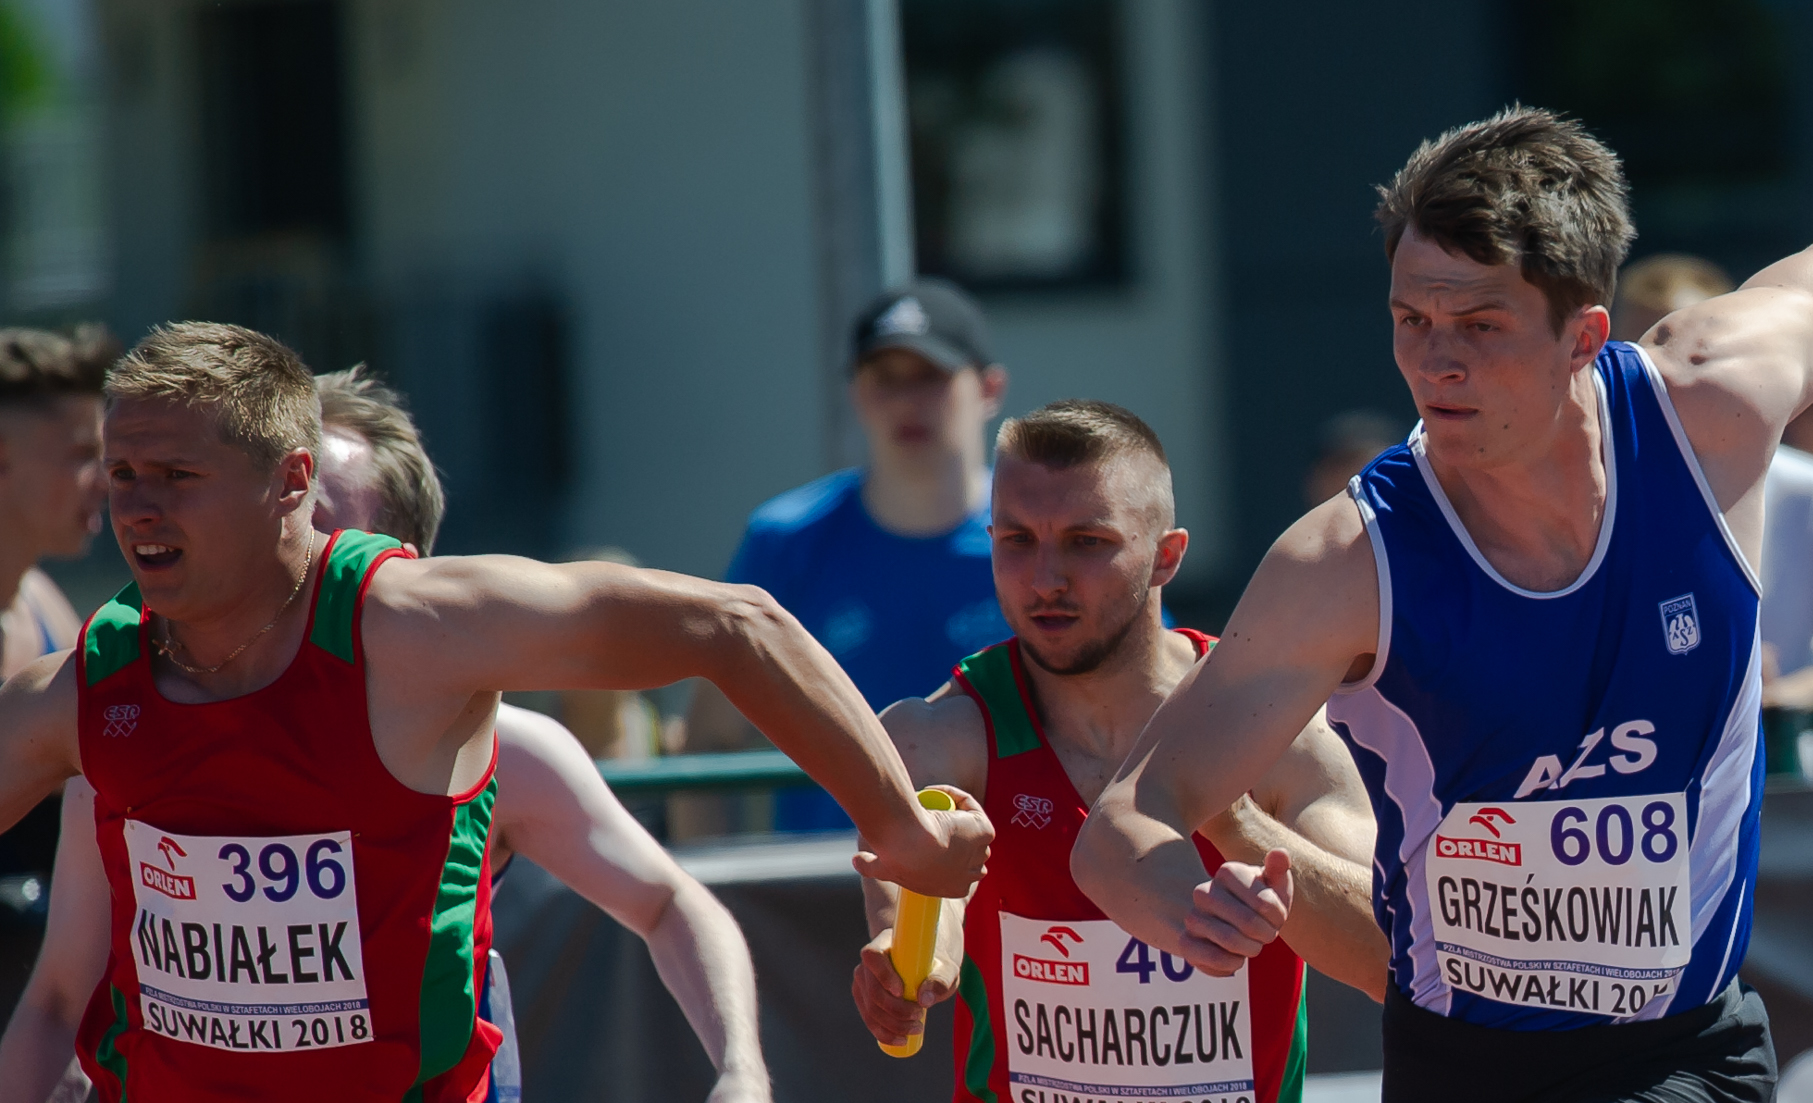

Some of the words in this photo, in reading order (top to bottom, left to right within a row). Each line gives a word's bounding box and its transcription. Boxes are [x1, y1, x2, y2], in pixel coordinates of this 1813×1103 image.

[1513, 719, 1657, 799] AZS
[1439, 840, 1516, 863] ORLEN
[1550, 801, 1678, 866] 608
[143, 866, 190, 897] ORLEN
[217, 838, 346, 903] 396
[1437, 873, 1680, 948] GRZEŚKOWIAK
[137, 908, 355, 984] NABIAŁEK
[1016, 959, 1084, 983] ORLEN
[1443, 944, 1462, 955] PZLA
[1462, 949, 1512, 968] MISTRZOSTWA
[1513, 961, 1542, 970] POLSKI
[1553, 962, 1600, 975] SZTAFETACH
[1605, 967, 1663, 978] WIELOBOJACH
[223, 1005, 230, 1013] W
[231, 1005, 278, 1014] SZTAFETACH
[283, 1002, 342, 1014] WIELOBOJACH
[343, 1001, 361, 1010] 2018
[1446, 957, 1600, 1011] SUWAŁKI
[148, 1002, 282, 1049] SUWAŁKI
[292, 1014, 368, 1047] 2018
[1014, 998, 1243, 1067] SACHARCZUK
[1111, 1087, 1119, 1095] W
[1120, 1086, 1168, 1096] SZTAFETACH
[1173, 1082, 1229, 1095] WIELOBOJACH
[1229, 1082, 1247, 1091] 2018
